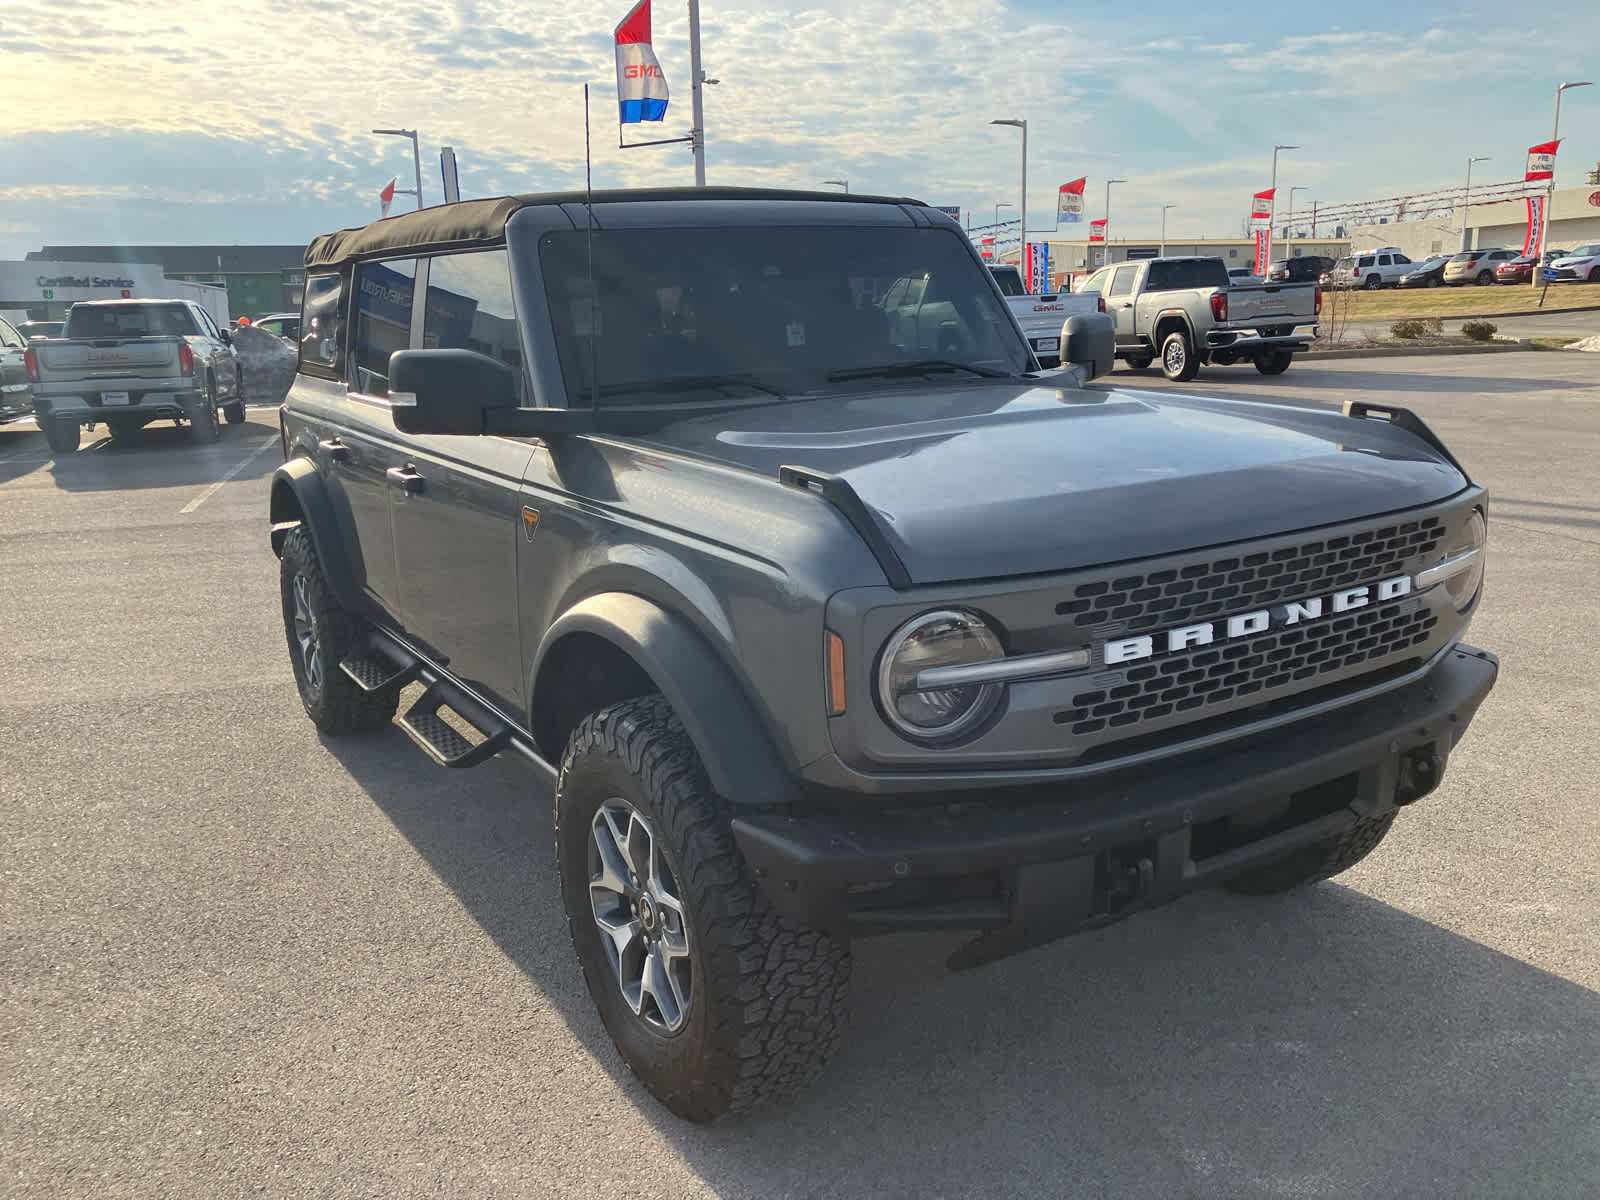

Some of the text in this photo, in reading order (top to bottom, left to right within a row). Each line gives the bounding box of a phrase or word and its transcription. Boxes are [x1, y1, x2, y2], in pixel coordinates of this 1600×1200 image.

[624, 64, 663, 79] GMC
[36, 275, 135, 288] Certified Service
[1104, 575, 1411, 665] BRONCO
